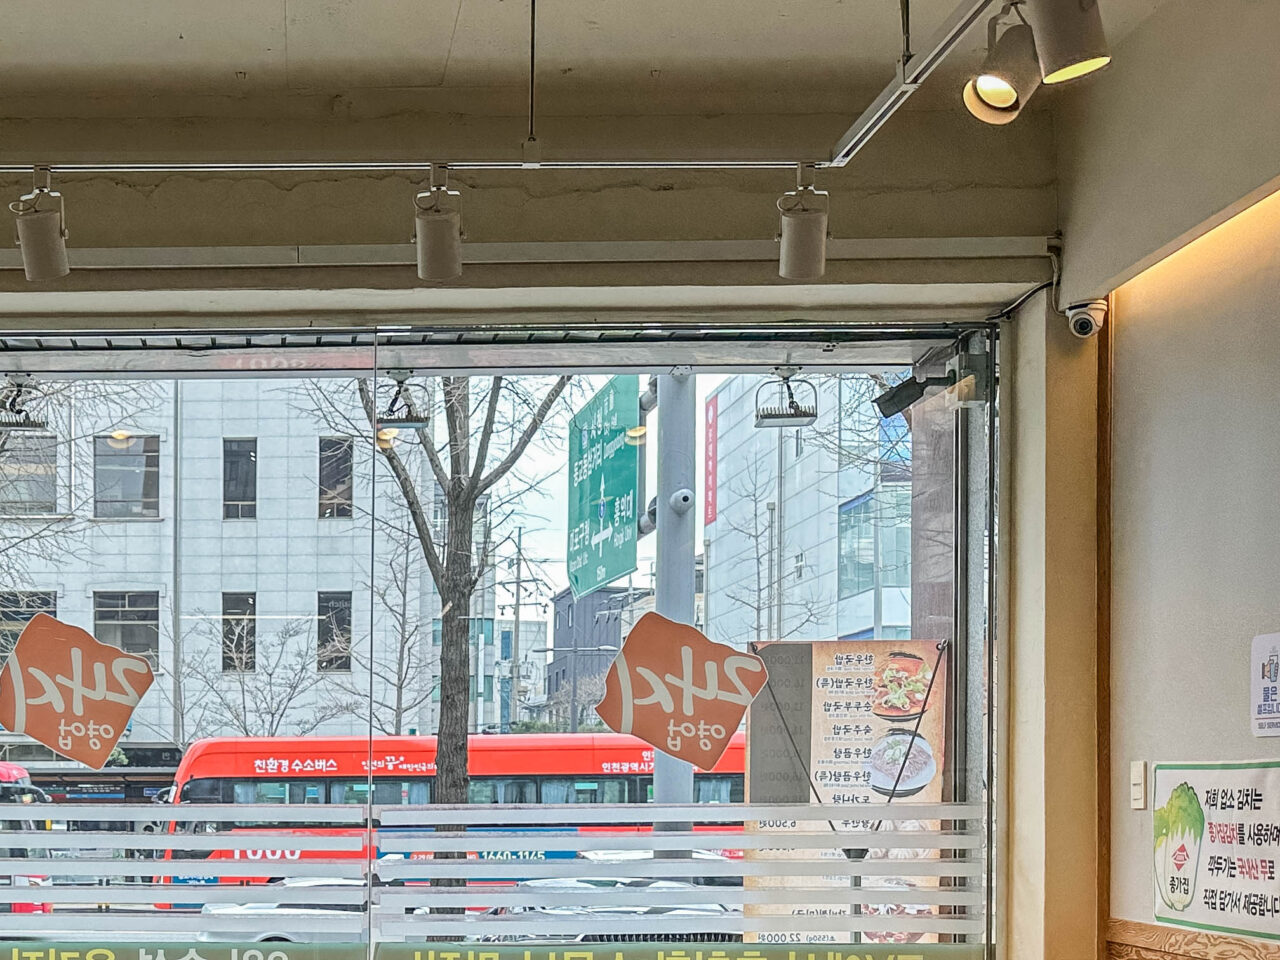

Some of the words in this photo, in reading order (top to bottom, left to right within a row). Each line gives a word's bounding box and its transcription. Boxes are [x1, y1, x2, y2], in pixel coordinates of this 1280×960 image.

[254, 758, 289, 773] 친환경
[291, 758, 338, 773] 수소버스
[1205, 788, 1219, 809] 저희
[1220, 788, 1235, 809] 업소
[1237, 788, 1263, 810] 김치는
[1169, 876, 1189, 894] 종가집
[1203, 889, 1218, 910] 직접
[1219, 890, 1242, 913] 담가서
